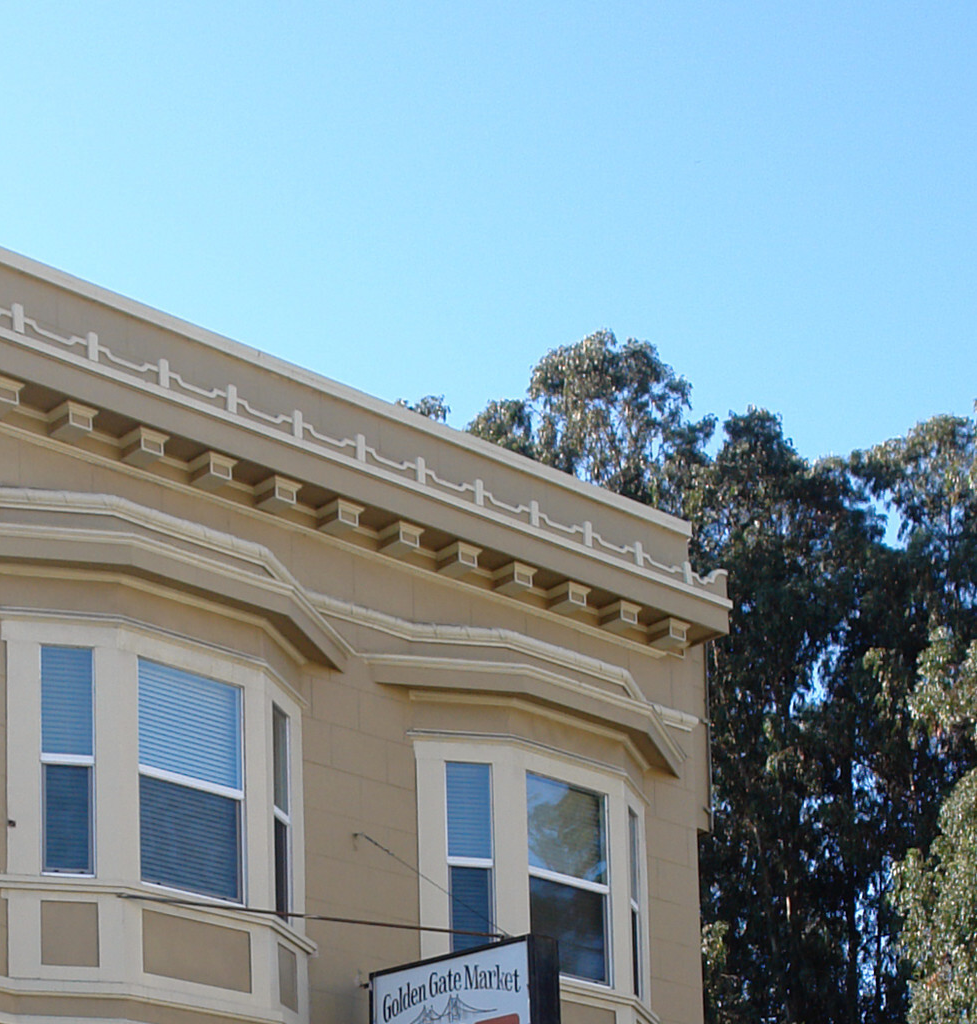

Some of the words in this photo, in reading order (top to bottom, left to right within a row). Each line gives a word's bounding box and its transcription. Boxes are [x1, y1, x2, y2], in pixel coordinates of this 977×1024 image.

[383, 982, 427, 1023] Golden
[429, 968, 462, 998] Gate
[464, 964, 521, 993] Market
